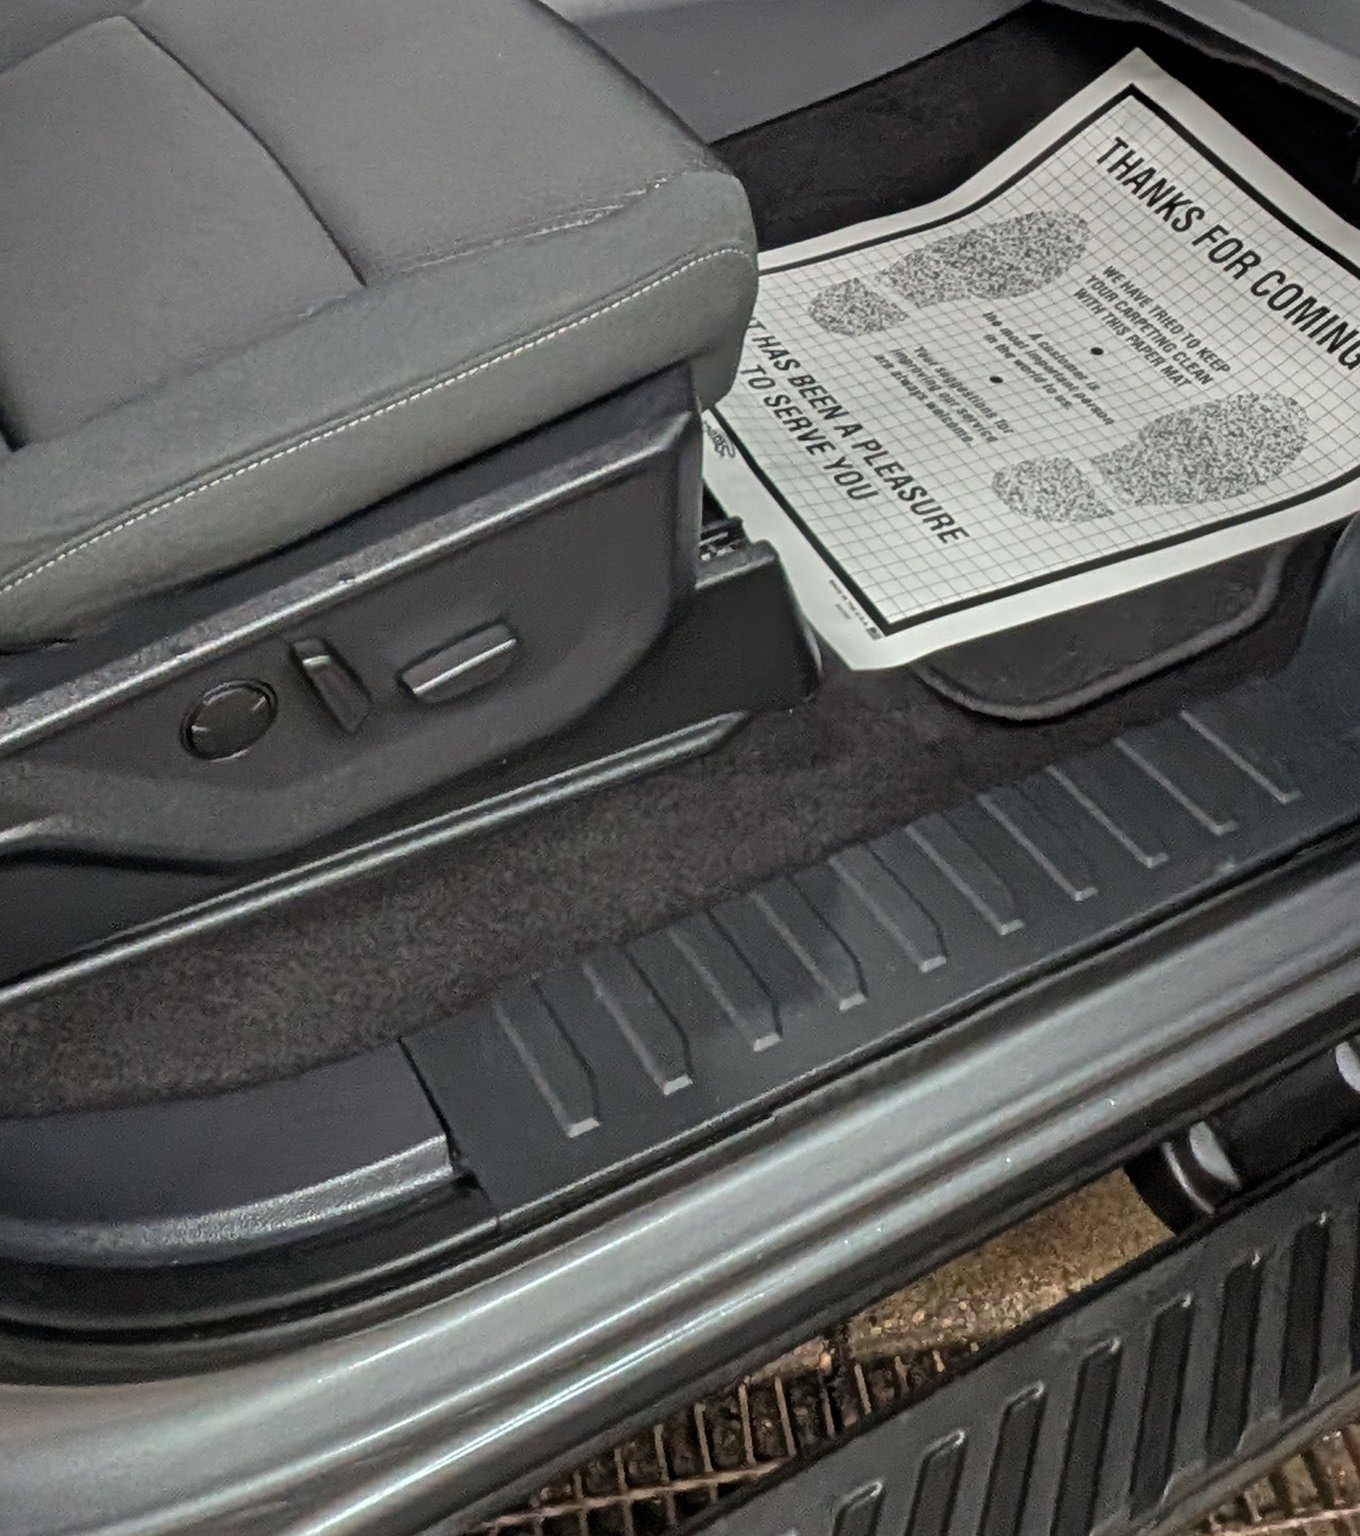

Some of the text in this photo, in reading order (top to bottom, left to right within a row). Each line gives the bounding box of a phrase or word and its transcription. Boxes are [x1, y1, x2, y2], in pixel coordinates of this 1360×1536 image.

[1096, 137, 1205, 232] THANKS
[1192, 224, 1261, 280] FOR
[982, 311, 1115, 426] the most important person
[994, 343, 1016, 359] the
[1014, 359, 1048, 384] world
[1042, 382, 1057, 395] to
[1028, 333, 1101, 393] A customer is
[1073, 287, 1192, 388] WITH THIS PAPER MAT
[1085, 274, 1214, 385] YOUR CARPETING CLEAN
[1102, 265, 1231, 374] WE HAVE TRIED TO KEEP
[873, 354, 895, 370] are
[890, 370, 929, 402] always
[914, 346, 1014, 434] Your suggestions for
[938, 392, 961, 407] our
[956, 408, 999, 443] service
[740, 365, 879, 501] TO SERVE YOU
[752, 335, 801, 372] HAS
[790, 374, 850, 420] BEEN
[833, 422, 863, 438] A
[851, 439, 971, 545] PLEASURE
